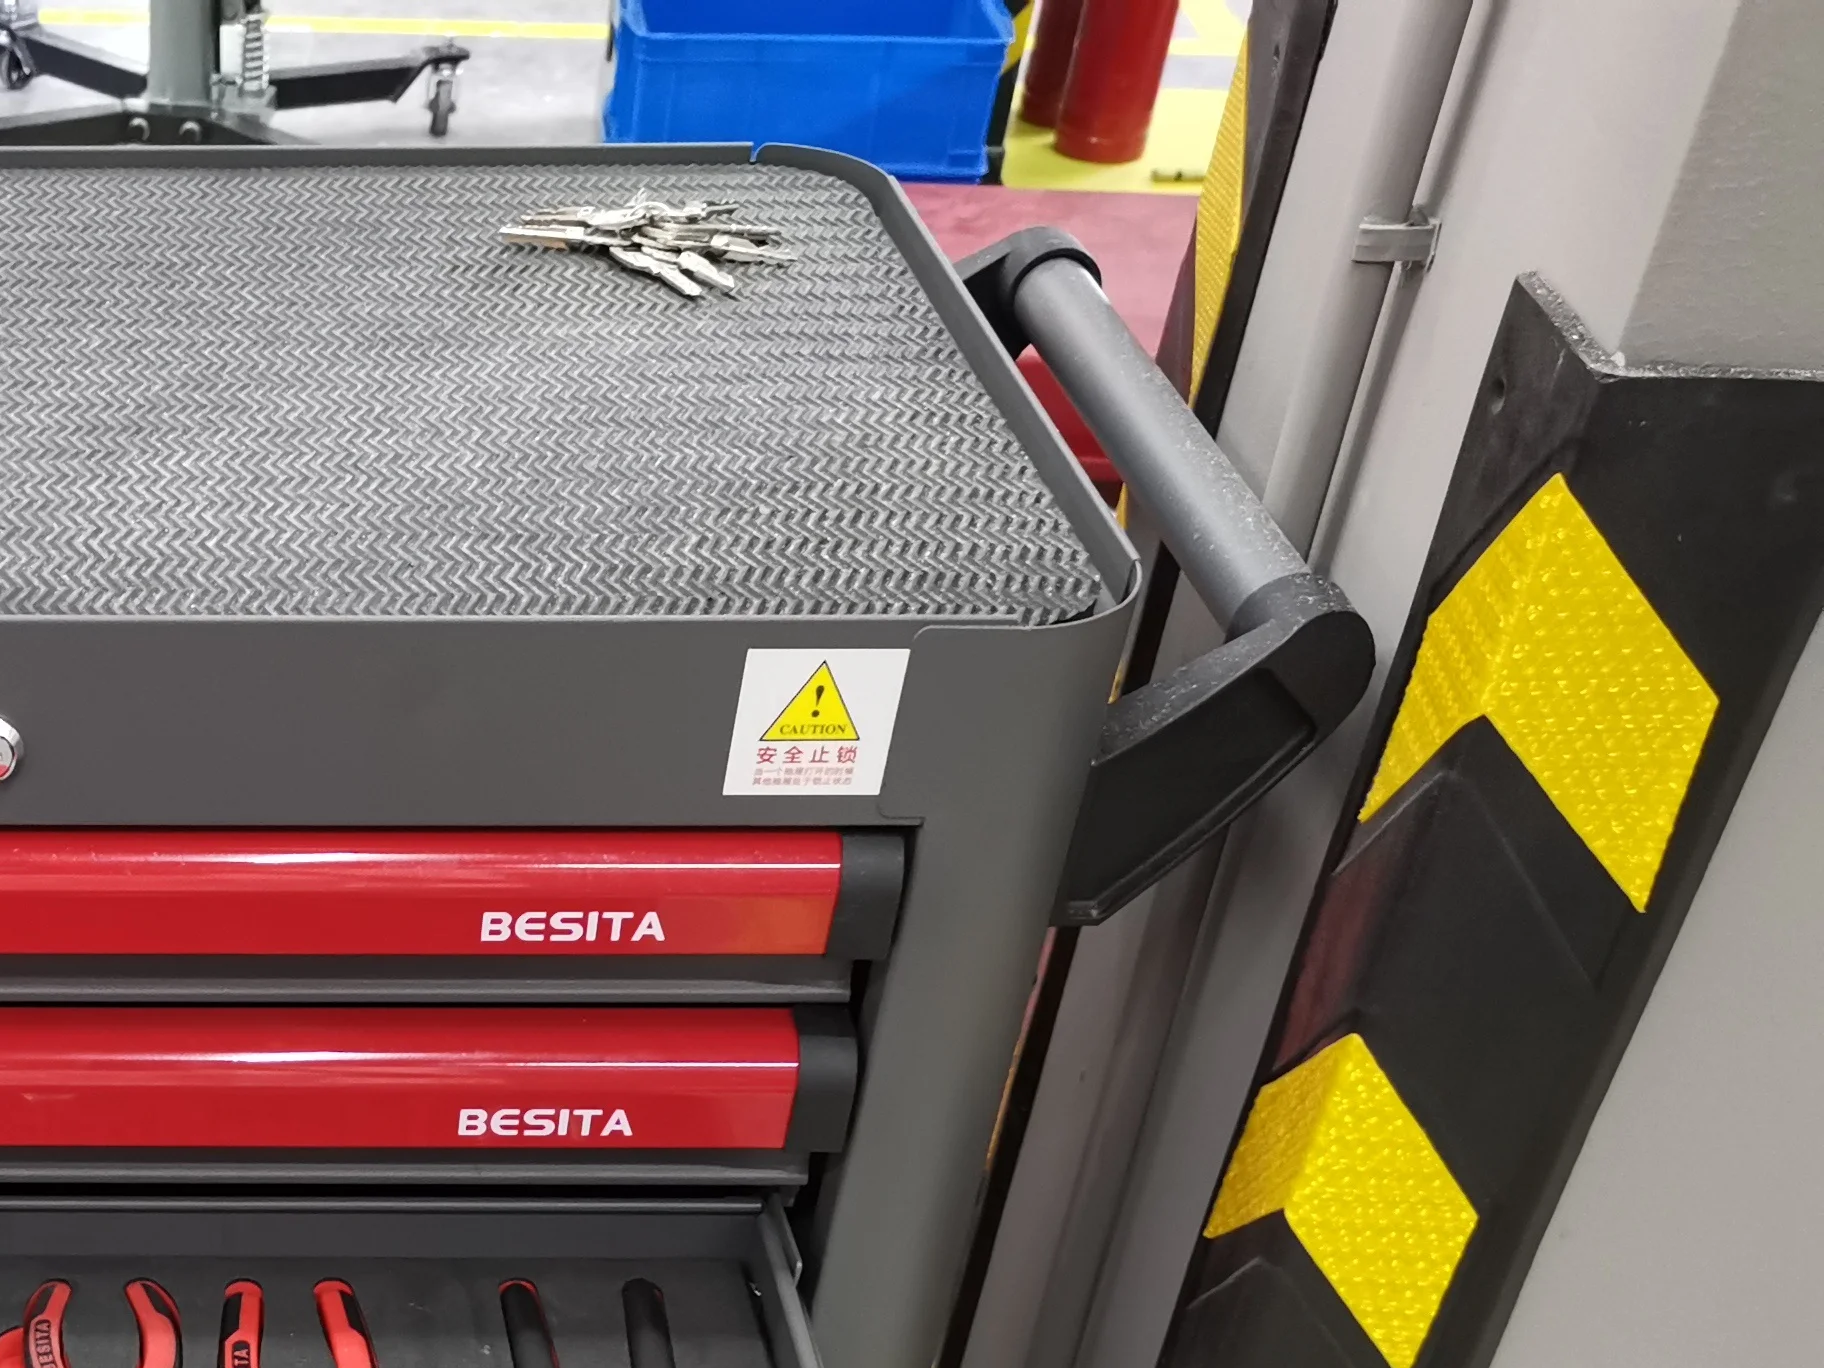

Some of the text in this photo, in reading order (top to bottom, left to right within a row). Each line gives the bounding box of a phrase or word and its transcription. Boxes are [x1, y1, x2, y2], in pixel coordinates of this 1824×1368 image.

[780, 724, 847, 735] CAUTION
[756, 746, 858, 764] 安全止锁
[480, 911, 665, 942] BESITA
[457, 1108, 633, 1137] BESITA
